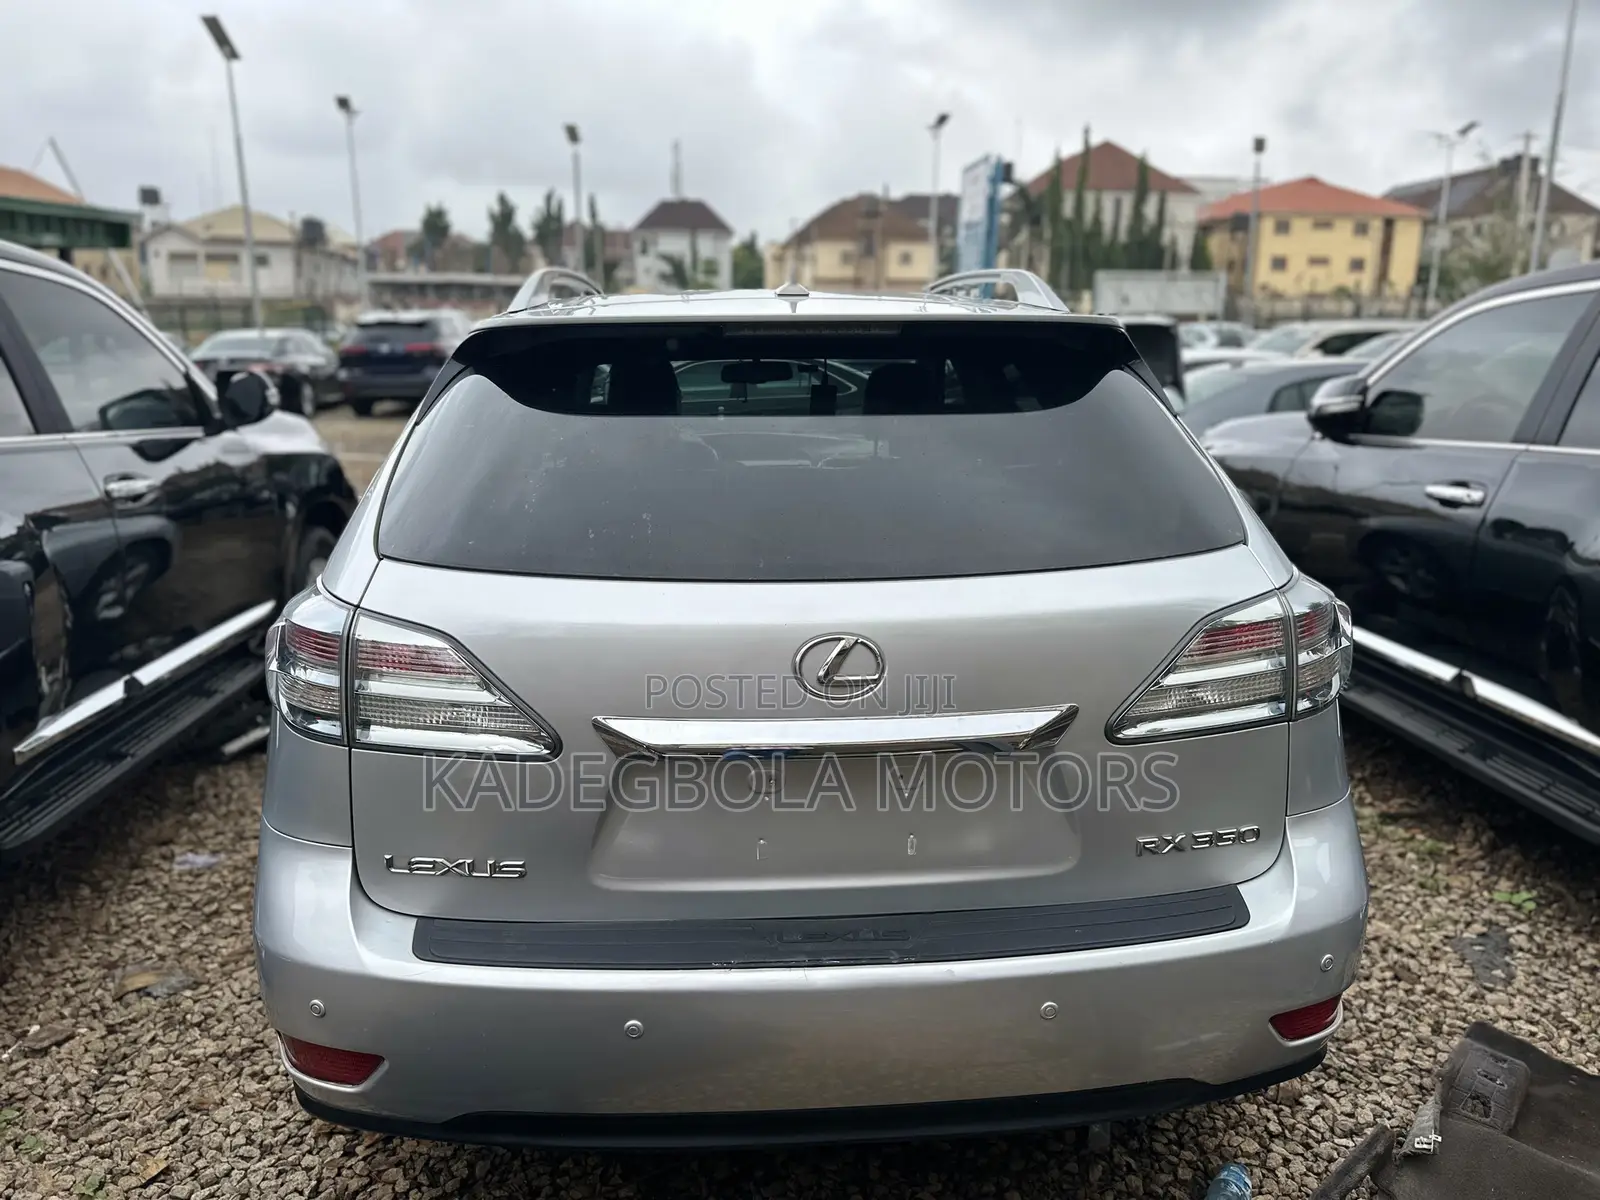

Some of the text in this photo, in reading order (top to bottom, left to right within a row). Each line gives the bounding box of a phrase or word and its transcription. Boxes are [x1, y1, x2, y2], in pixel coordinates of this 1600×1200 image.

[1135, 824, 1261, 857] RX 350
[383, 853, 528, 879] LEXUS
